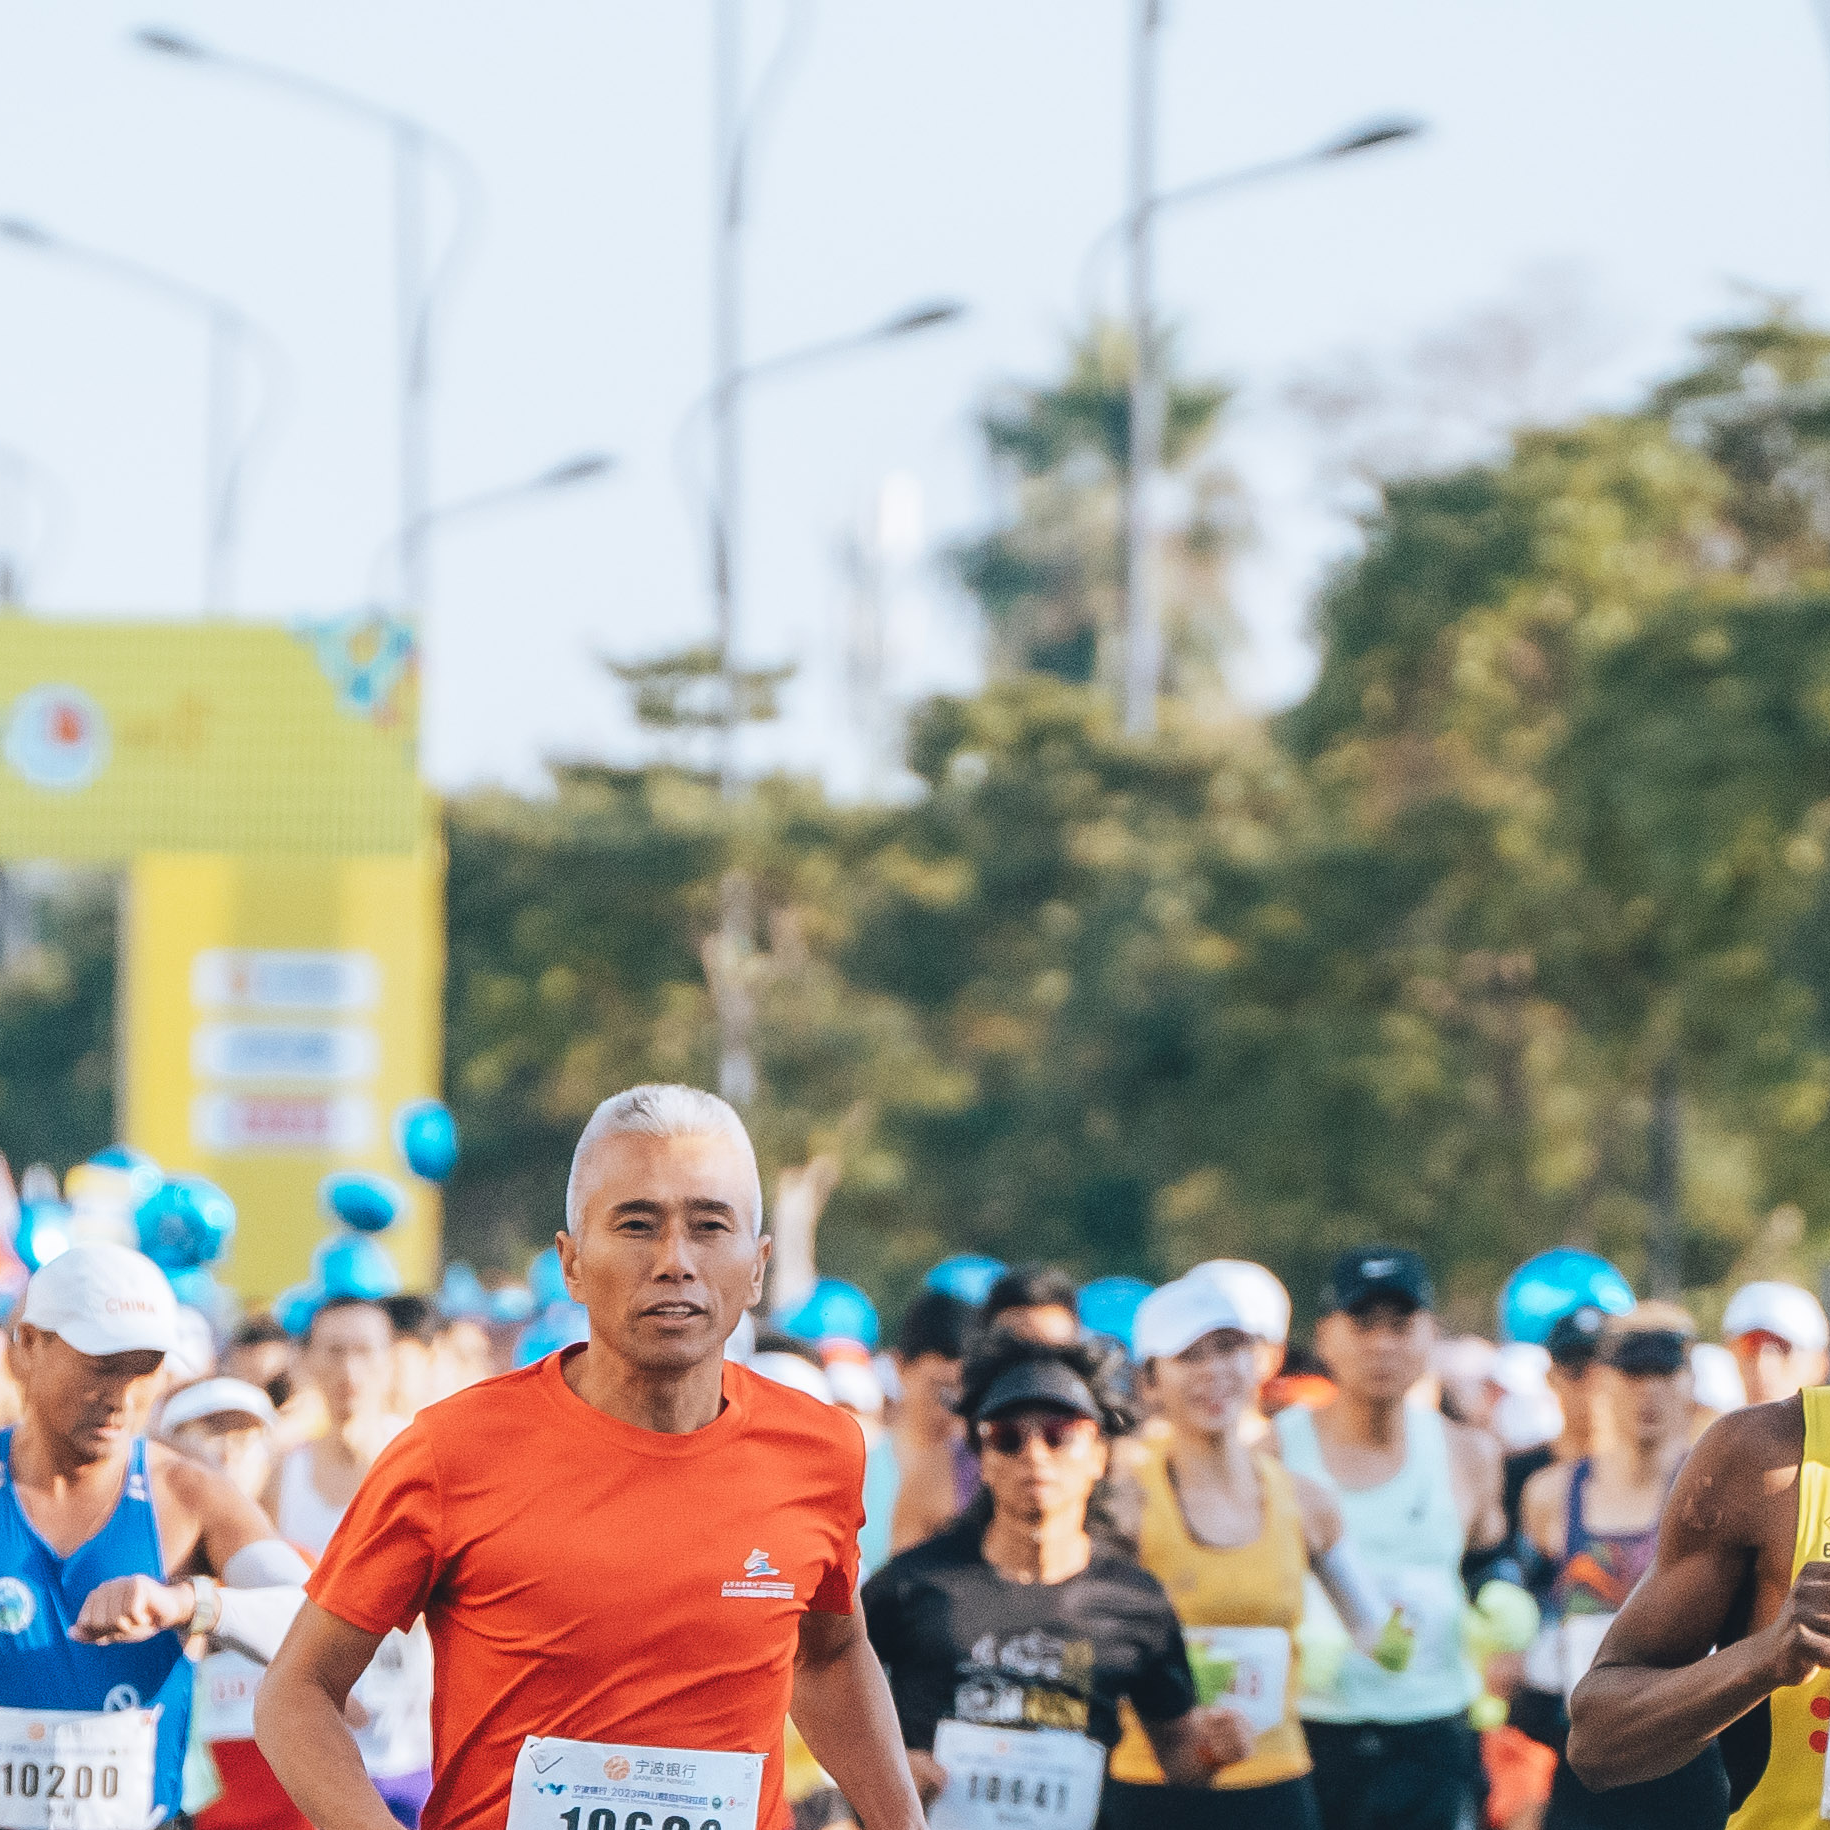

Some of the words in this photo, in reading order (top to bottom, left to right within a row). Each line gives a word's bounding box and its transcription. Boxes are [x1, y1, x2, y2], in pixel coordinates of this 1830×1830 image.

[106, 1298, 156, 1314] CHINA
[635, 1760, 697, 1779] 宁波银行
[1, 1761, 119, 1799] 10200
